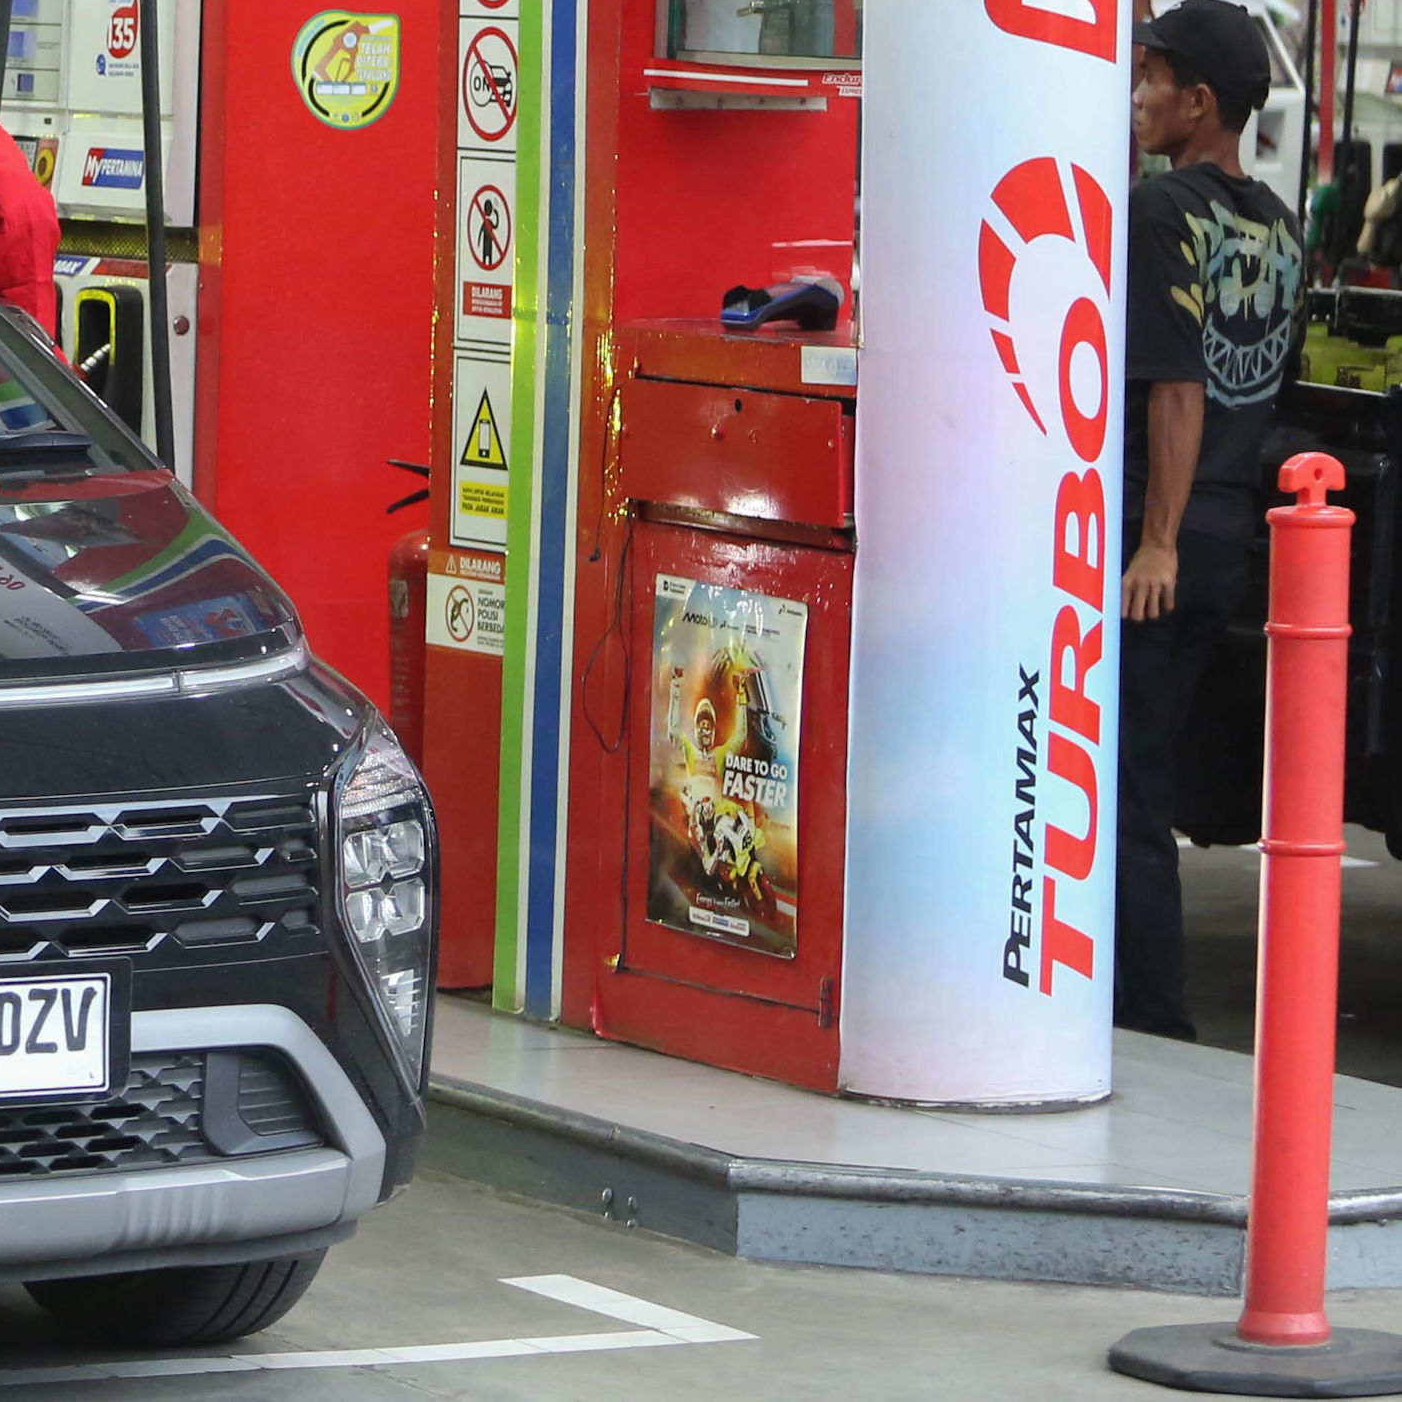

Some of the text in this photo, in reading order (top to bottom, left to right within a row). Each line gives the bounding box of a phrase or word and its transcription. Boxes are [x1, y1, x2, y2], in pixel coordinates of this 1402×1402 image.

[108, 17, 134, 50] 135
[85, 155, 143, 183] MyPERTAMINA
[472, 286, 503, 300] DILARANG
[460, 557, 501, 575] DILARANG
[477, 609, 498, 621] POLISI
[478, 597, 505, 609] NOMOR
[1039, 295, 1112, 997] TURBO
[725, 754, 788, 780] DARE TO GO
[723, 770, 788, 807] FASTER
[1002, 663, 1042, 988] PERTAMAX
